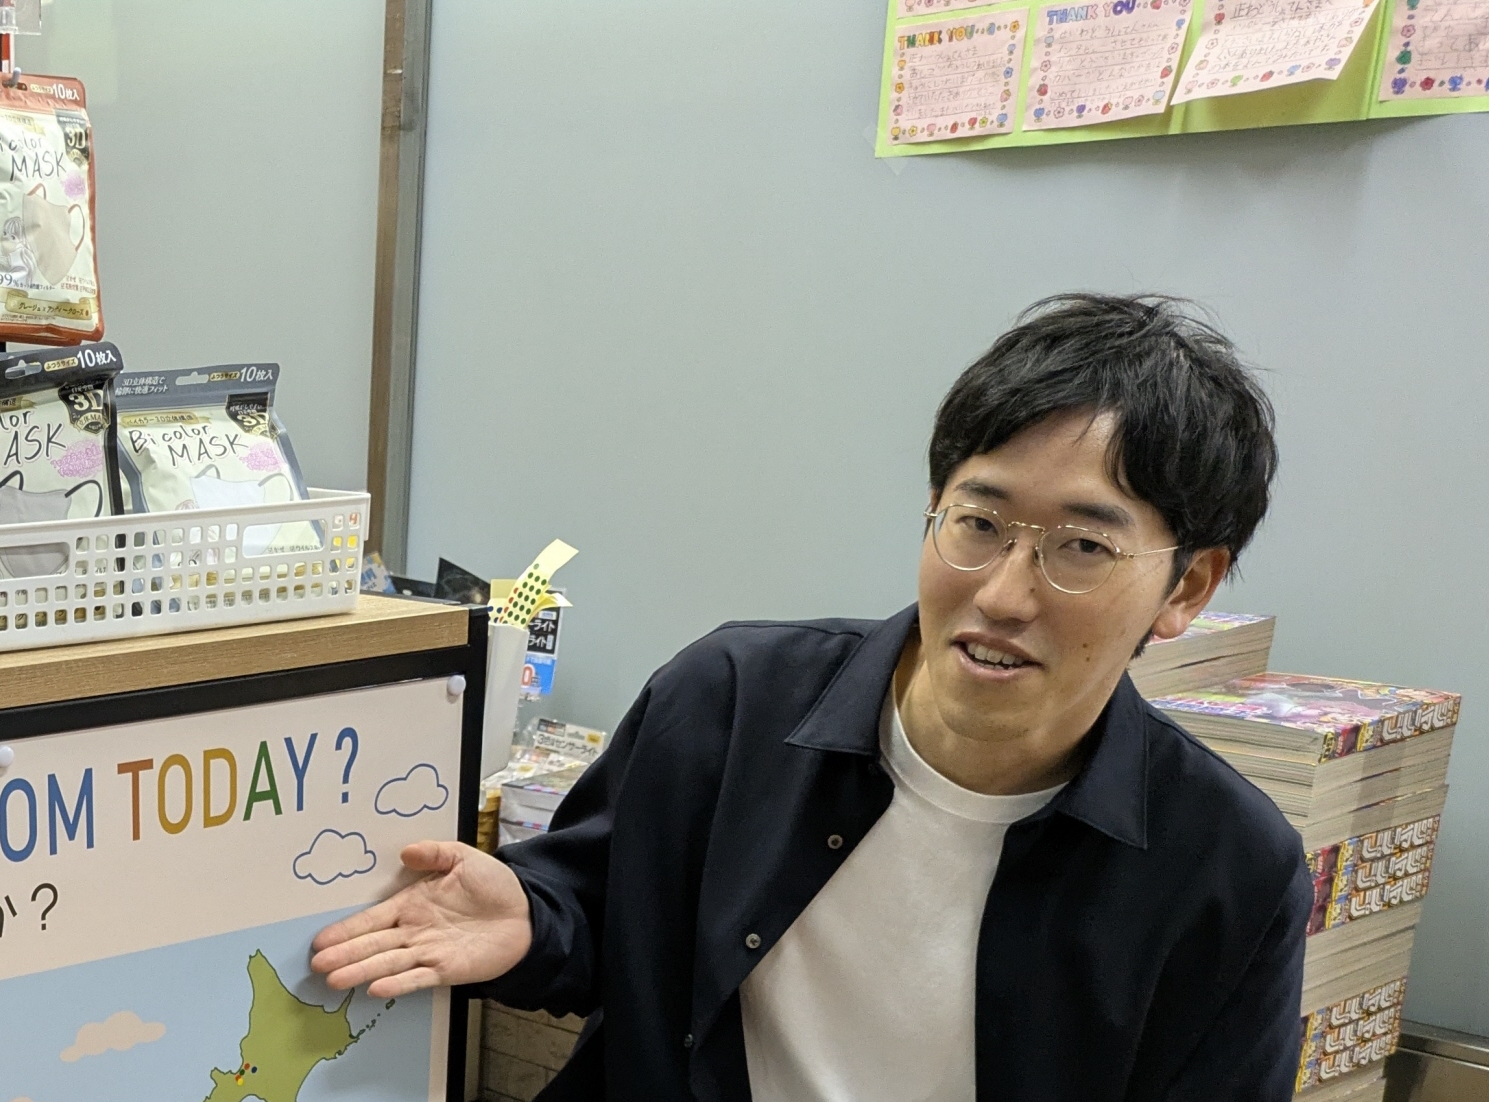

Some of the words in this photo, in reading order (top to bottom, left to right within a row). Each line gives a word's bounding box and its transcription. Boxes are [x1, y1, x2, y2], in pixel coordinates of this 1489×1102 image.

[1047, 4, 1097, 26] THANK
[898, 30, 943, 50] THANK
[946, 24, 975, 43] YOU
[52, 83, 80, 101] 10枚入
[67, 128, 86, 148] 3D
[10, 151, 67, 182] MASK
[77, 349, 117, 369] 10枚入
[122, 376, 166, 386] 3D立体構造で
[239, 366, 274, 383] 10枚入
[68, 388, 104, 411] 3D
[167, 434, 249, 467] MASK
[117, 732, 320, 843] TODAY
